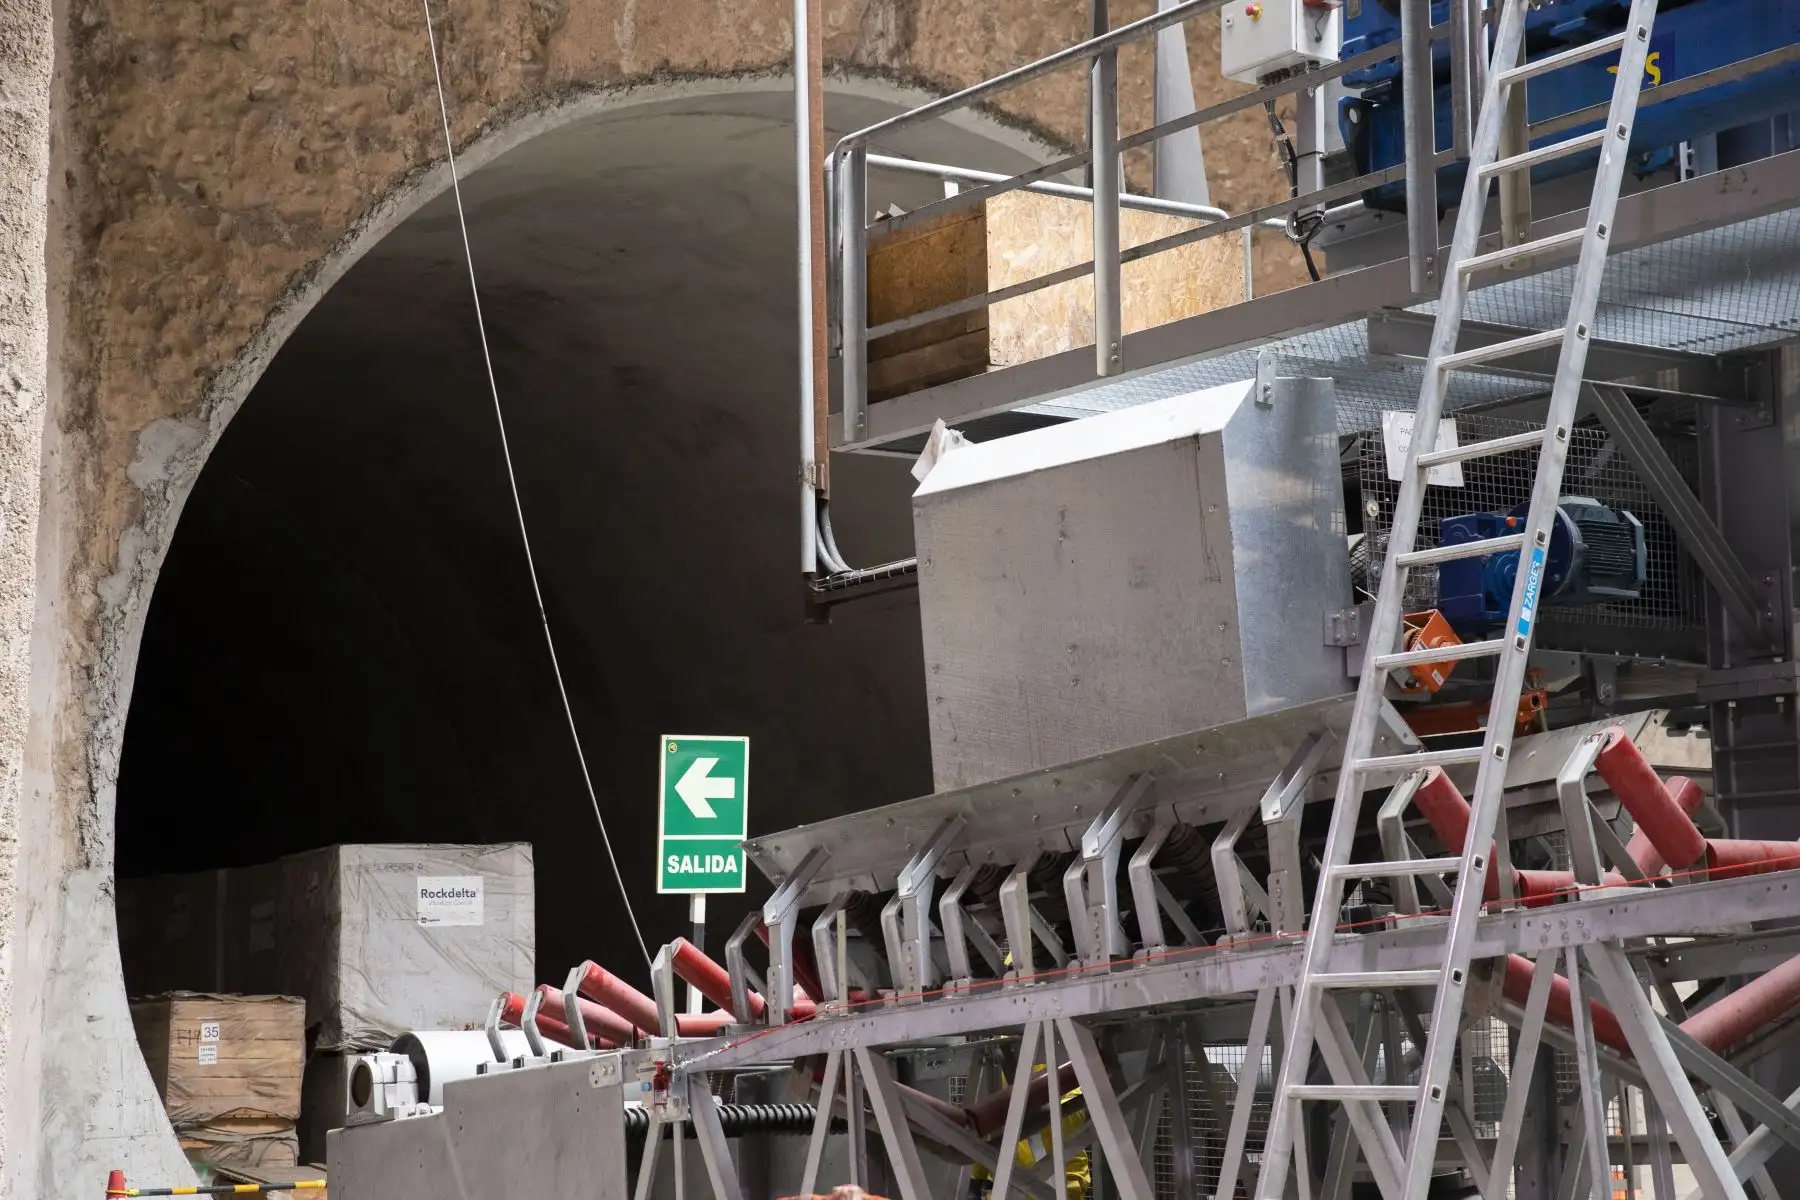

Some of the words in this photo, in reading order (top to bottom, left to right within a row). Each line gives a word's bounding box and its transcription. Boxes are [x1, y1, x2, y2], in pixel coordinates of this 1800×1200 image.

[1524, 560, 1541, 609] ZARGES
[667, 854, 738, 874] SALIDA
[420, 887, 477, 899] Rockdelta
[204, 1026, 219, 1038] 35
